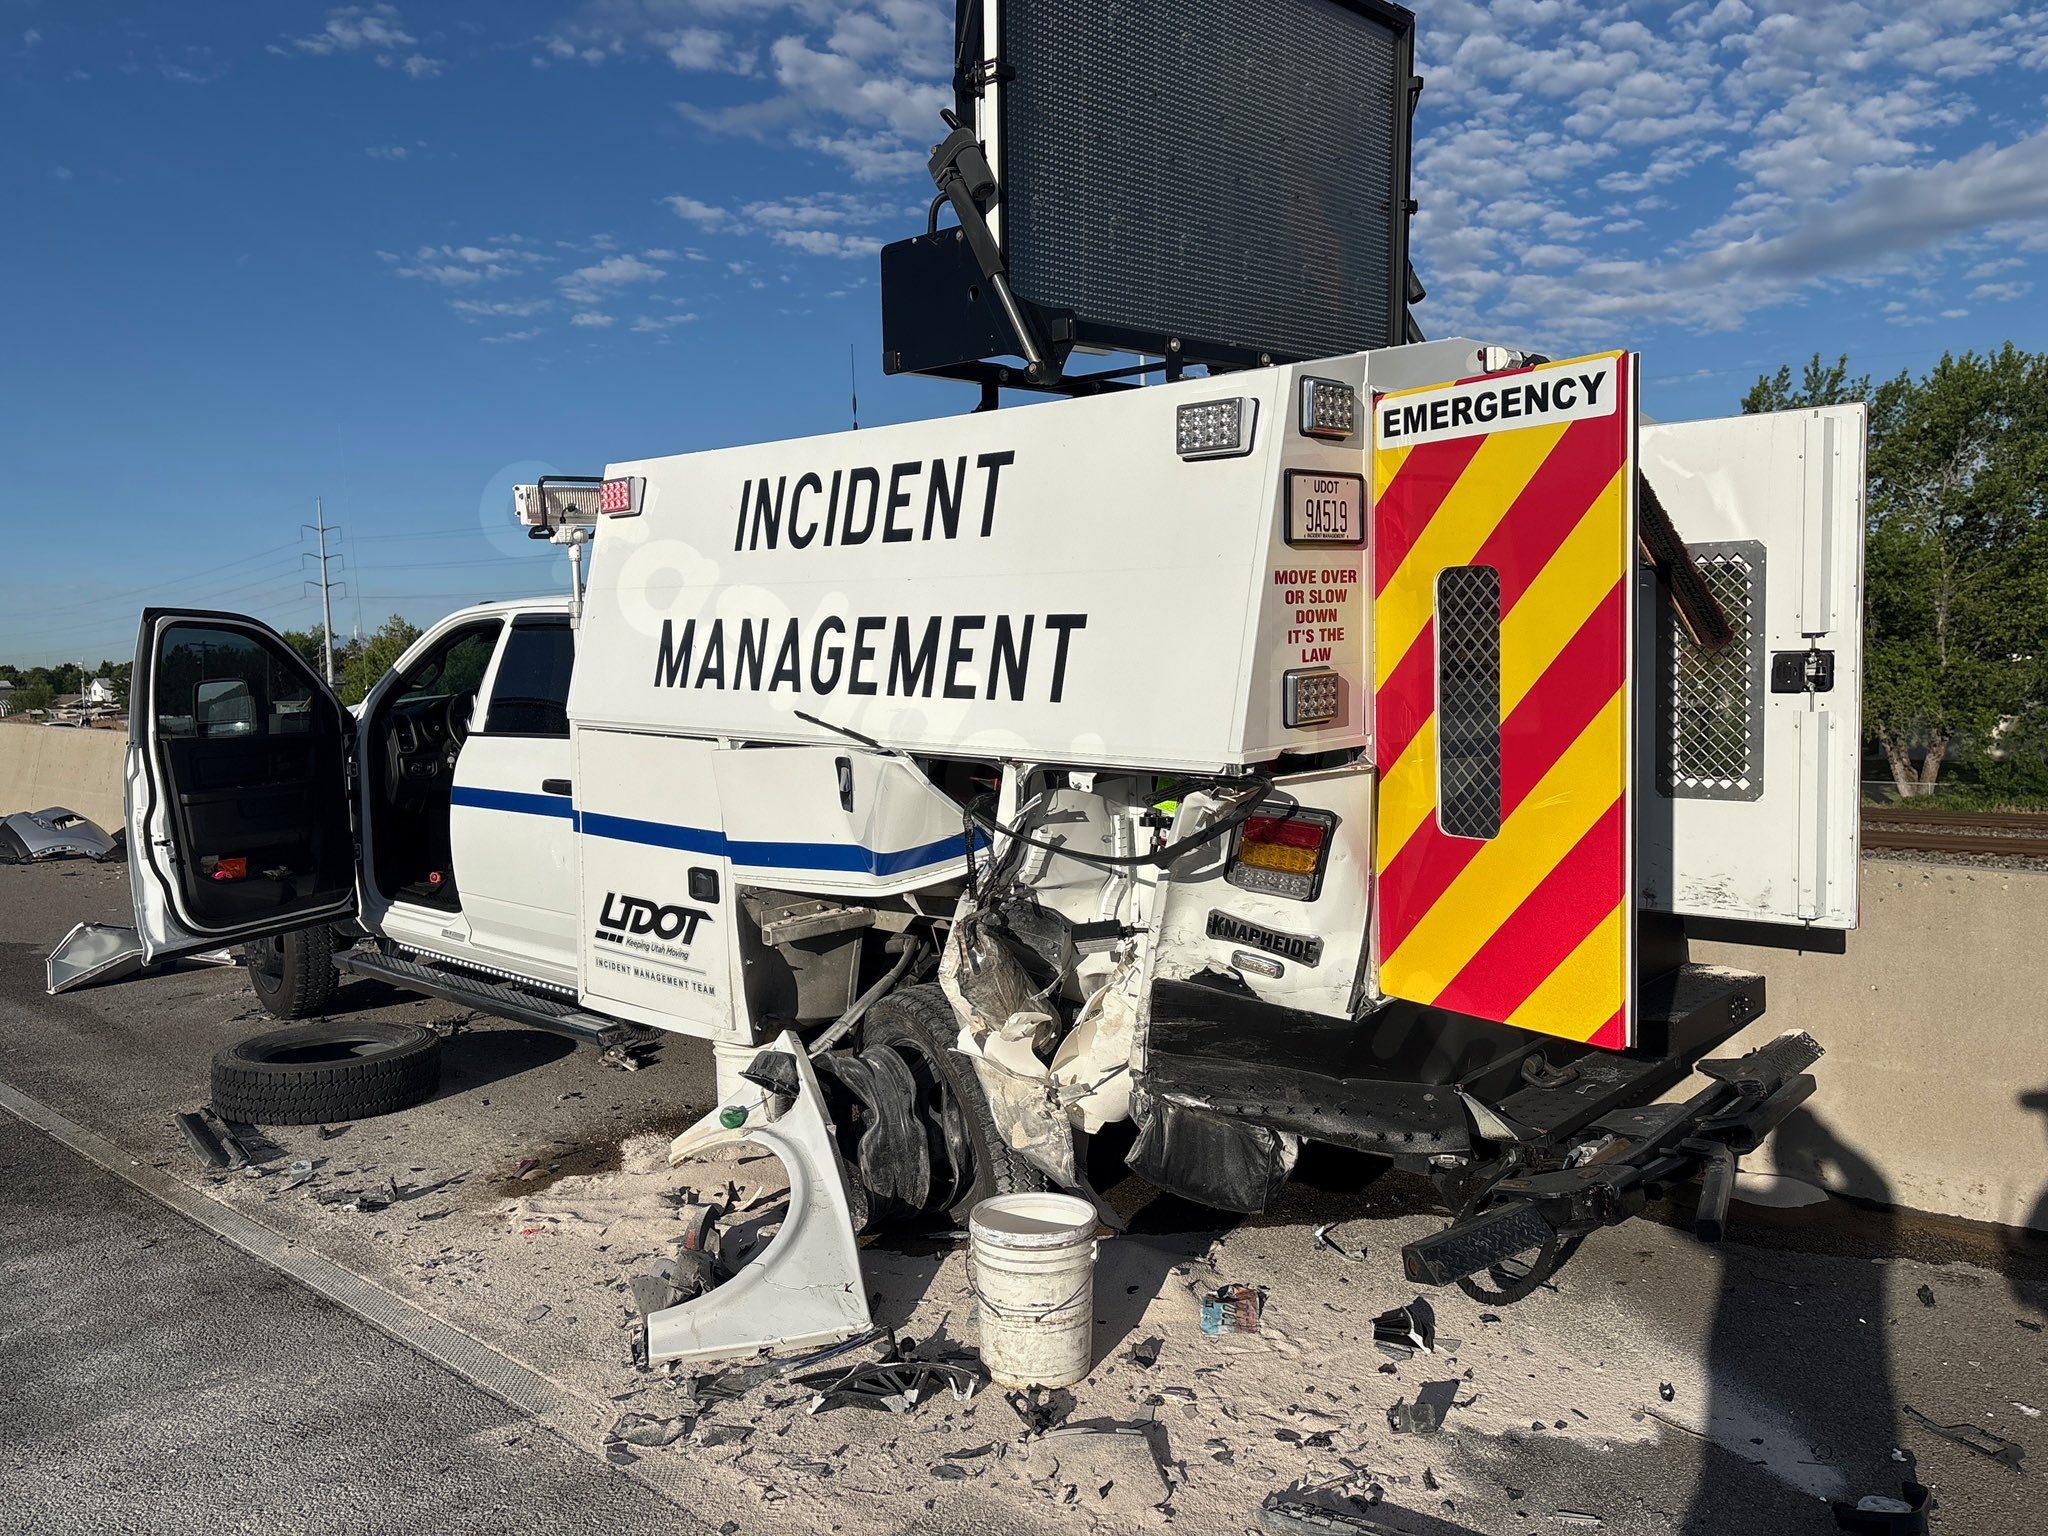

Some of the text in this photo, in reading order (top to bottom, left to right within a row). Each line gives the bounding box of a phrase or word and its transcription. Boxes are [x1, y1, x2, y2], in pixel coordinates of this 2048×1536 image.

[1383, 371, 1607, 438] EMERGENCY
[734, 450, 1015, 552] INCIDENT
[1314, 480, 1339, 494] UDOT
[1306, 499, 1347, 533] 9A519
[1274, 569, 1357, 585] MOVE OVER
[1285, 589, 1348, 605] OR SLOW
[1295, 609, 1337, 624] DOWN
[1288, 627, 1344, 644] IT'S THE
[654, 614, 1087, 703] MANAGEMENT
[1302, 647, 1331, 663] LAW
[600, 892, 714, 945] UDOT
[626, 938, 689, 961] Keeping Utah Moving
[1211, 913, 1318, 963] KNAPHEIDE
[595, 958, 715, 995] INCIDENT MANAGEMENT TEAM
